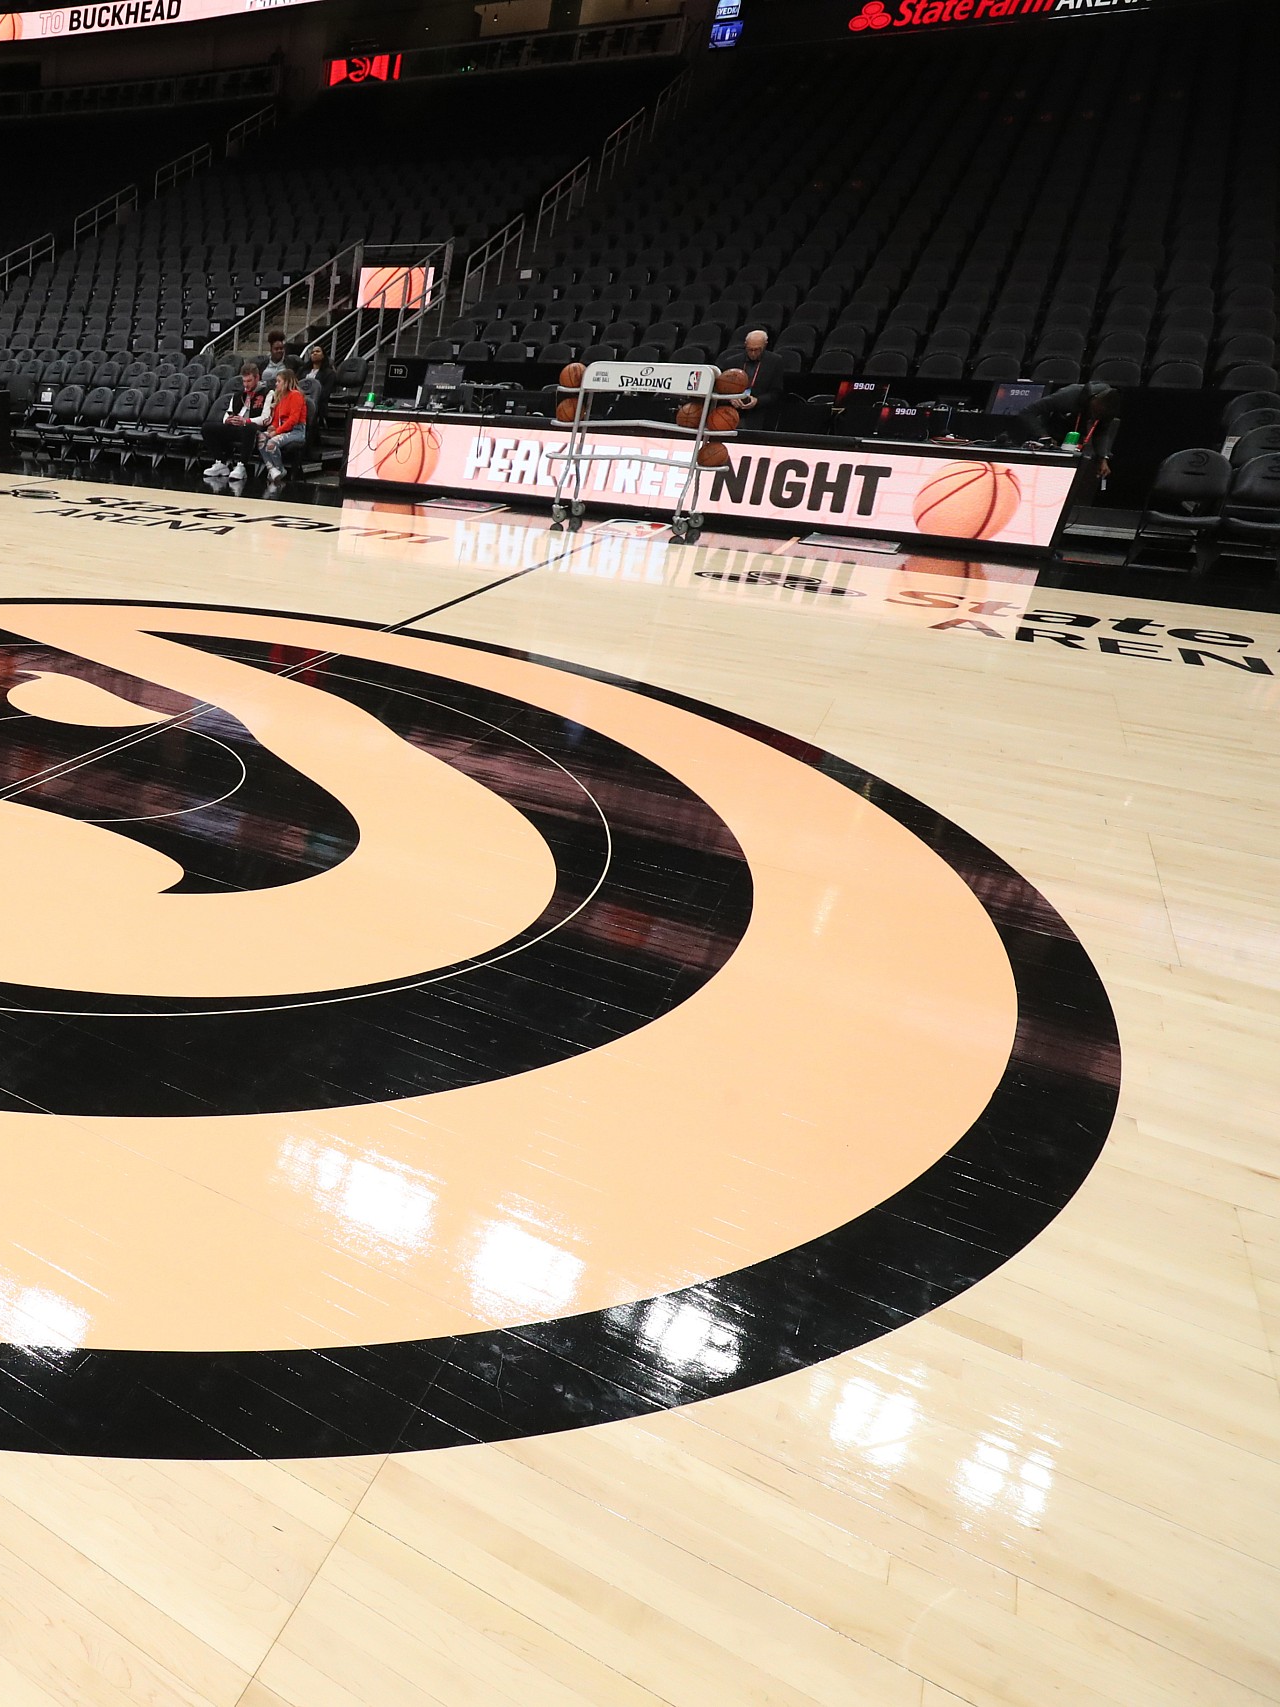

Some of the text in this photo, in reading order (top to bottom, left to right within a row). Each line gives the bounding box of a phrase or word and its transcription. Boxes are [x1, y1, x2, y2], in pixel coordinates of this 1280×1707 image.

[40, 11, 64, 35] TO
[69, 0, 182, 31] BUCKHEAD
[893, 0, 971, 27] State
[618, 375, 673, 390] SPALDING
[463, 436, 892, 516] PEACHTREE NIGHT
[34, 508, 239, 536] ARENA
[59, 496, 247, 520] State
[884, 590, 1255, 649] State
[927, 618, 1275, 676] AREN
